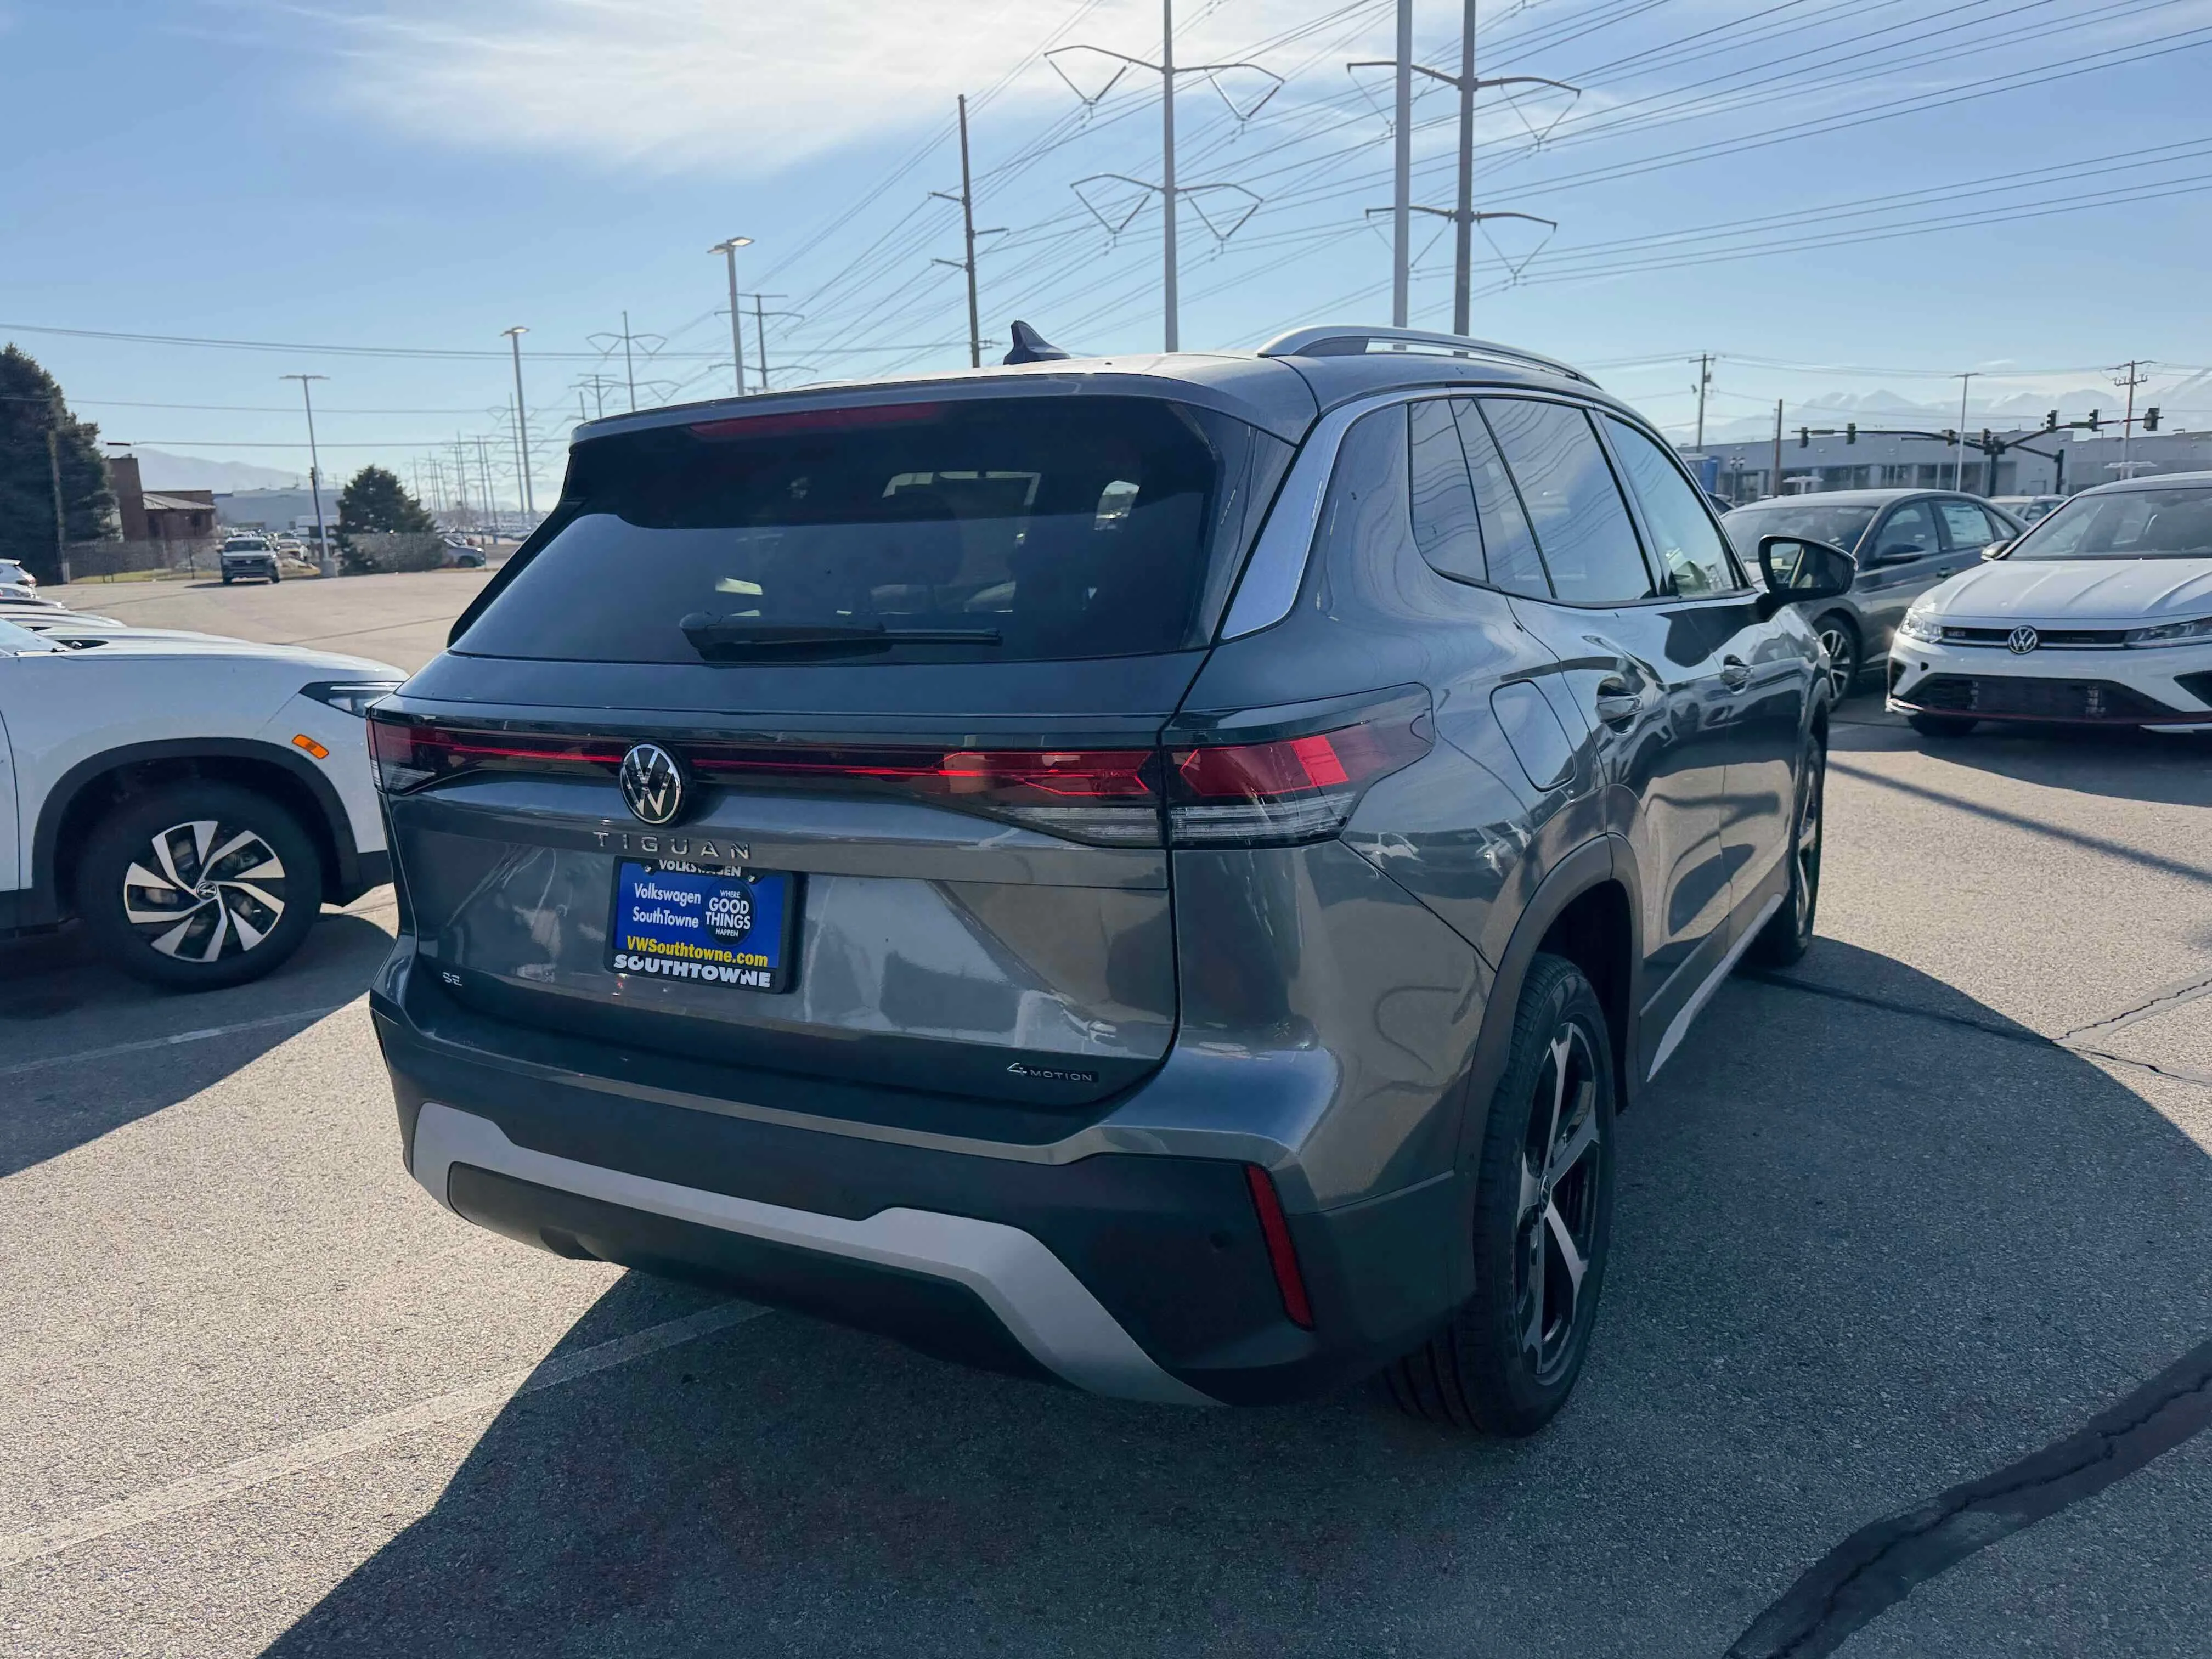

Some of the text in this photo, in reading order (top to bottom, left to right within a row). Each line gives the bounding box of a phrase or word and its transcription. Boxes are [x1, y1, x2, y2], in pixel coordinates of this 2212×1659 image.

[593, 831, 751, 860] TIGUAN
[659, 859, 741, 877] VOLKSEN
[634, 883, 701, 907] Volkswagen
[720, 889, 741, 898] WHERE
[709, 896, 749, 915] GOOD
[633, 907, 699, 928] SouthTowne
[705, 911, 751, 930] THINGS
[715, 928, 739, 938] HAPPEN
[627, 935, 768, 967] VWSouthtowne.com
[443, 972, 462, 986] SE
[614, 954, 771, 988] SOUTHTOWNE
